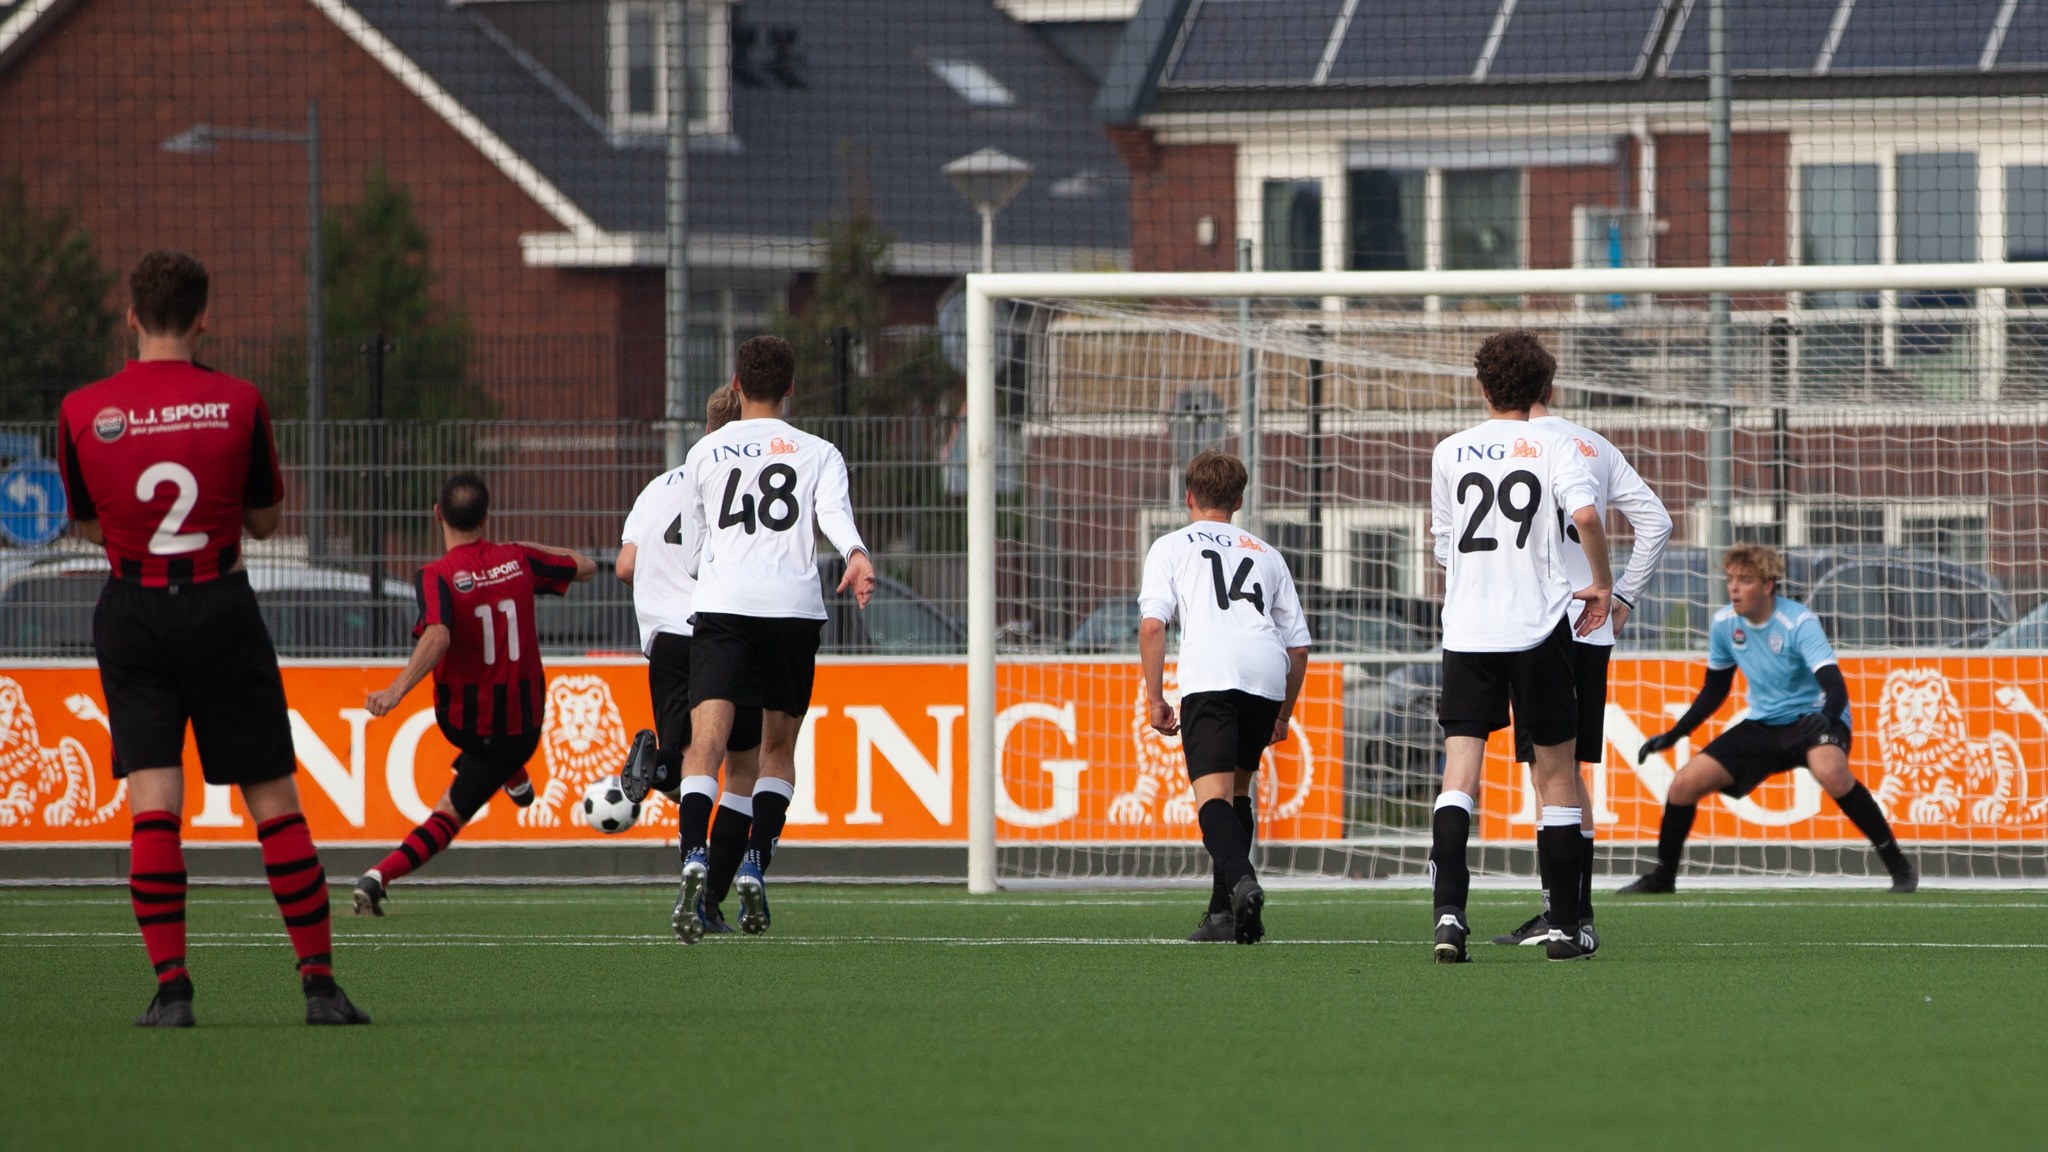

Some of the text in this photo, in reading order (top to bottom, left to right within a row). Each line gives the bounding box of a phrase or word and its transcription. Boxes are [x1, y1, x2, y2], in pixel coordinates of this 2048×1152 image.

[161, 403, 230, 422] SPORT
[713, 442, 762, 463] ING
[1456, 443, 1506, 463] ING
[136, 461, 209, 556] 2
[718, 462, 799, 535] 48
[1456, 469, 1542, 553] 29
[1186, 531, 1232, 548] ING
[1200, 549, 1266, 617] 14
[474, 598, 520, 665] 11
[785, 700, 1089, 828] ING
